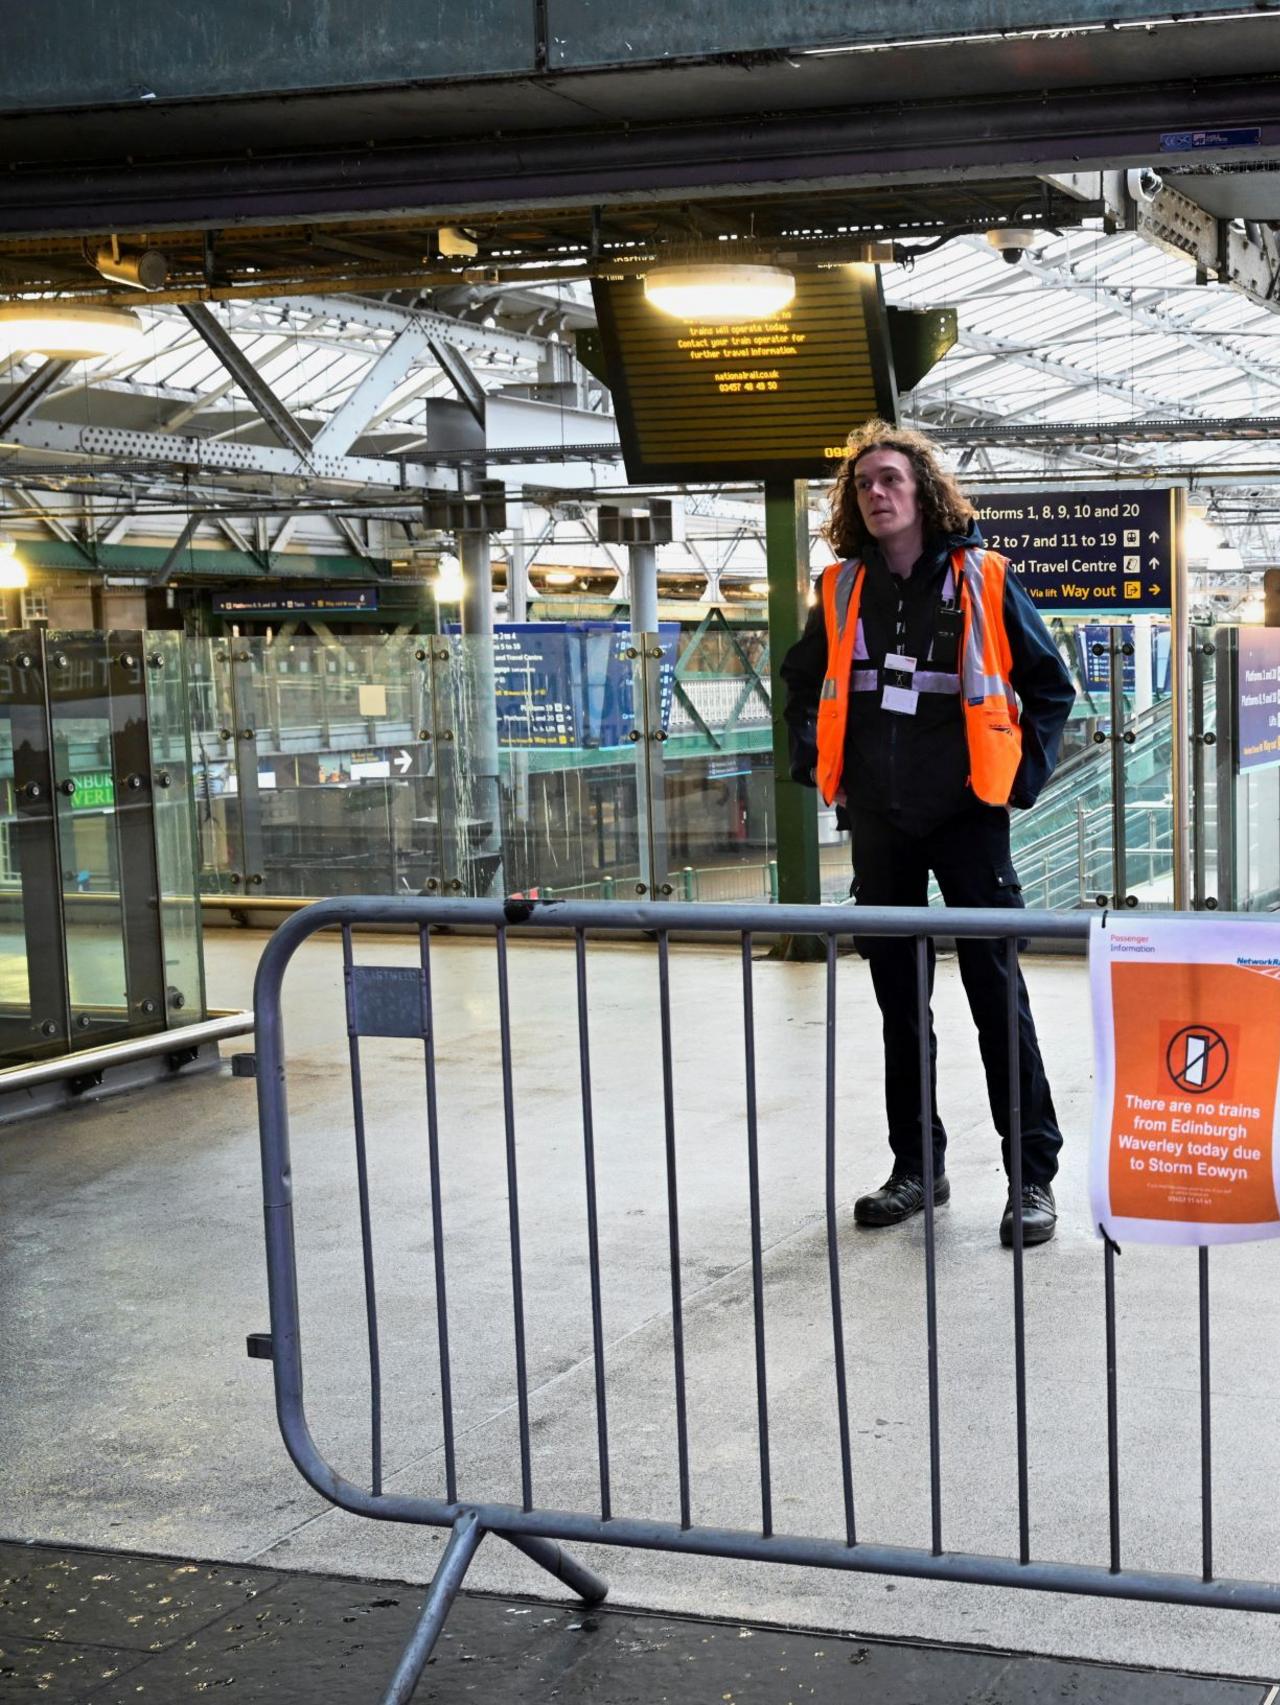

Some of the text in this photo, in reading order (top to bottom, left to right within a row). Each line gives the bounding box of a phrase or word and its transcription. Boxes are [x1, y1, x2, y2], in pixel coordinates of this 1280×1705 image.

[689, 327, 713, 336] trains
[716, 325, 729, 335] will
[731, 324, 763, 335] operate
[678, 334, 806, 348] Contact your train operator for
[690, 350, 720, 359] further
[723, 348, 750, 357] travel
[714, 370, 779, 381] nationalrail.co.uk
[973, 503, 1140, 521] atforms 1, 8, 9, 10 and 20
[992, 535, 1001, 548] 2
[1004, 536, 1018, 548] to
[1021, 535, 1030, 547] 7
[1033, 534, 1057, 547] and
[1061, 534, 1078, 547] 11
[1081, 534, 1096, 547] to
[1100, 533, 1117, 546] 19
[1011, 559, 1118, 573] nd Travel Centre
[1030, 584, 1118, 600] Via lift Way out
[1110, 934, 1149, 944] Passenger
[1110, 944, 1156, 953] Information
[1125, 1093, 1261, 1119] There are no trains
[1133, 1115, 1247, 1141] from Edinburgh
[1118, 1134, 1261, 1161] Waverley today due
[1130, 1157, 1248, 1182] to Storm Eowyn
